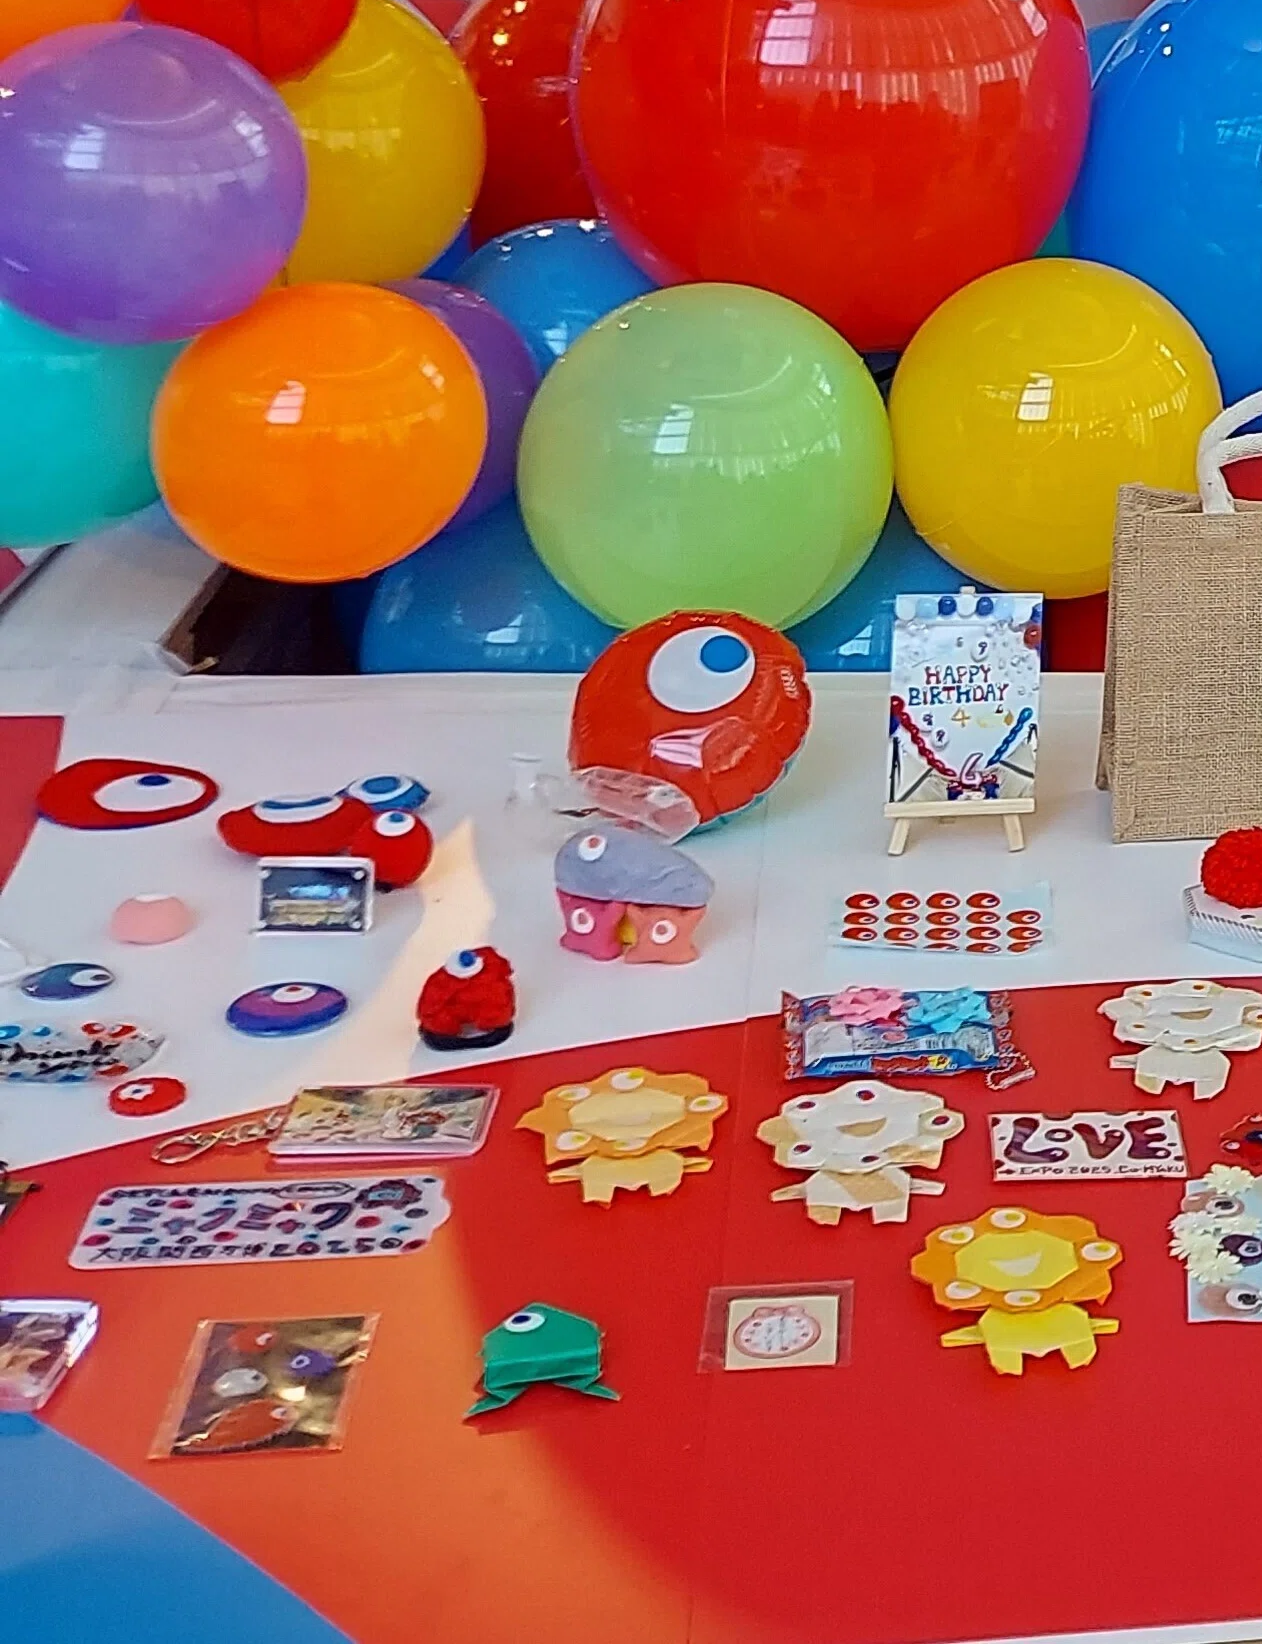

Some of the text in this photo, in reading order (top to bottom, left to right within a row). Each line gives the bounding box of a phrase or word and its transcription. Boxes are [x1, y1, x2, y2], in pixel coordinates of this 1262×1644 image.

[924, 664, 991, 685] HAPPY
[908, 683, 1009, 706] BIRTHDAY
[1004, 1117, 1172, 1164] LOVE
[110, 1202, 354, 1236] ミャクミャク
